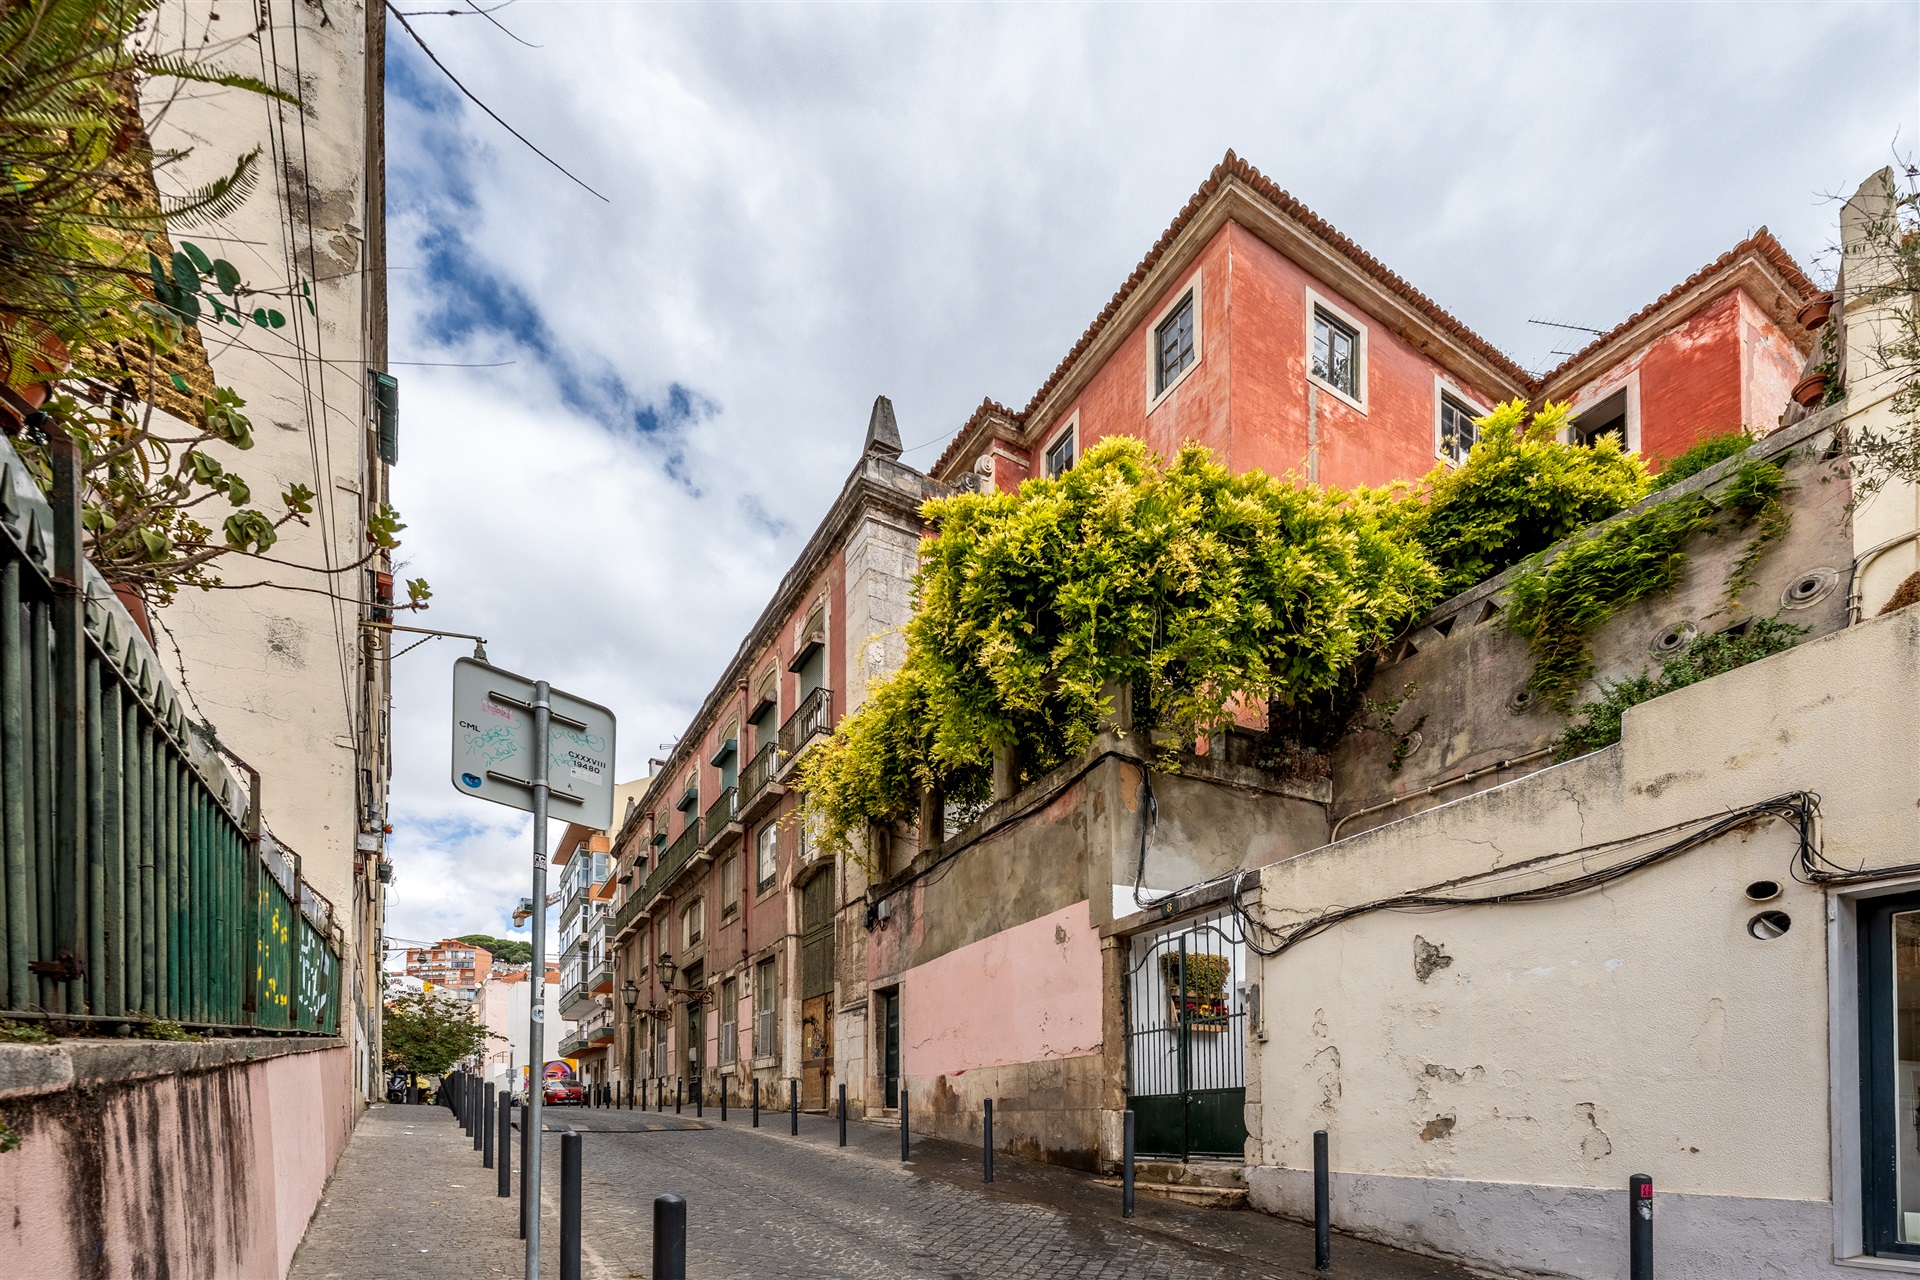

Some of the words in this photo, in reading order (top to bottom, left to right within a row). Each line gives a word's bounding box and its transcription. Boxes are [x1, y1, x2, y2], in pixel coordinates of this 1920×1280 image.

[459, 720, 481, 733] CML
[568, 750, 606, 769] CXXXVIII
[573, 760, 600, 774] 19480
[1166, 902, 1173, 912] 8
